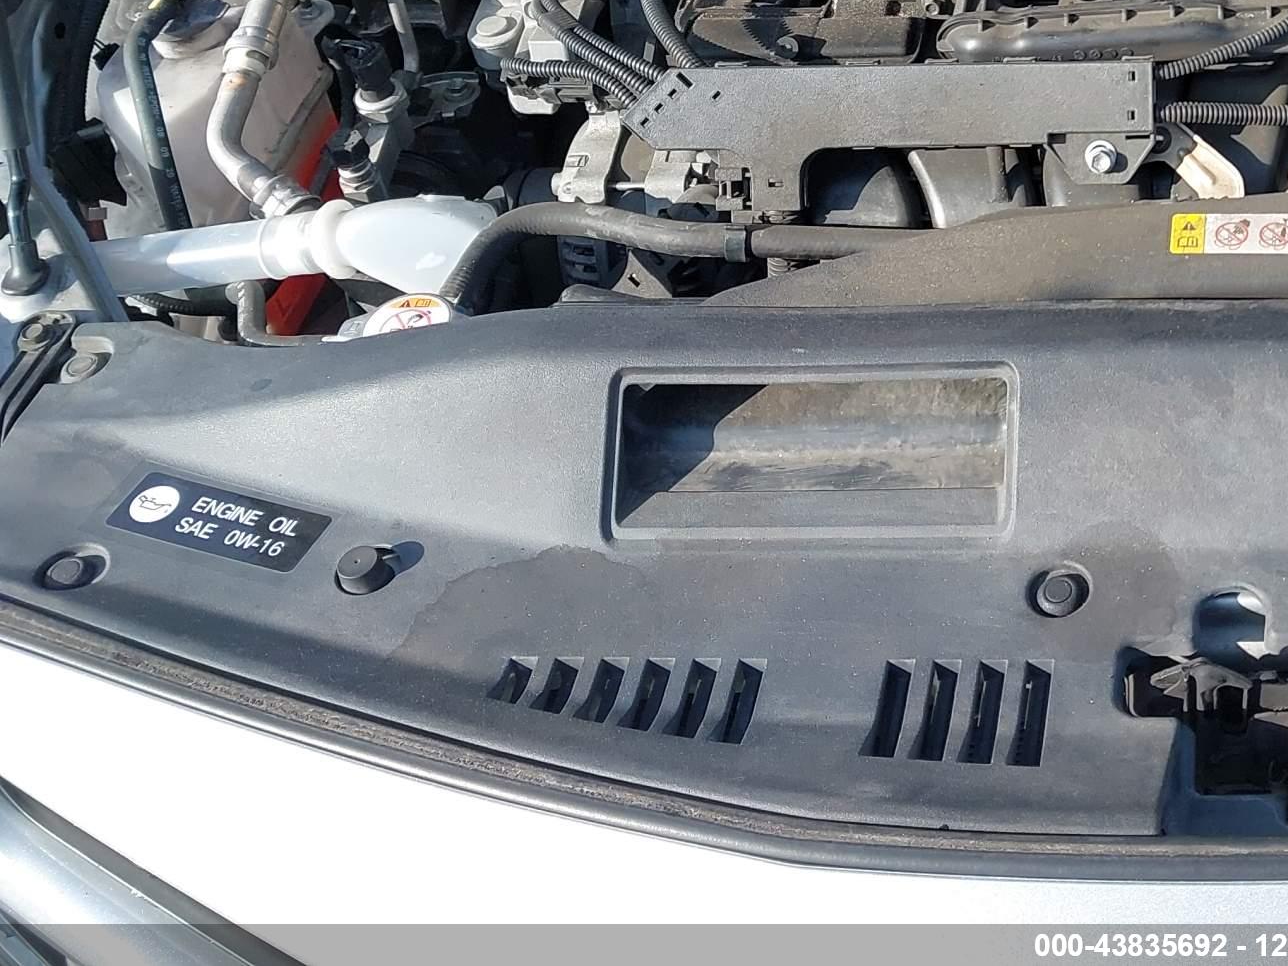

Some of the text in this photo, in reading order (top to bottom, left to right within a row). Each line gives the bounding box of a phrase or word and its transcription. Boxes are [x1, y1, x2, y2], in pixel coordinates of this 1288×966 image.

[191, 496, 300, 537] ENGINE OIL
[174, 517, 285, 557] SAE 0W-16
